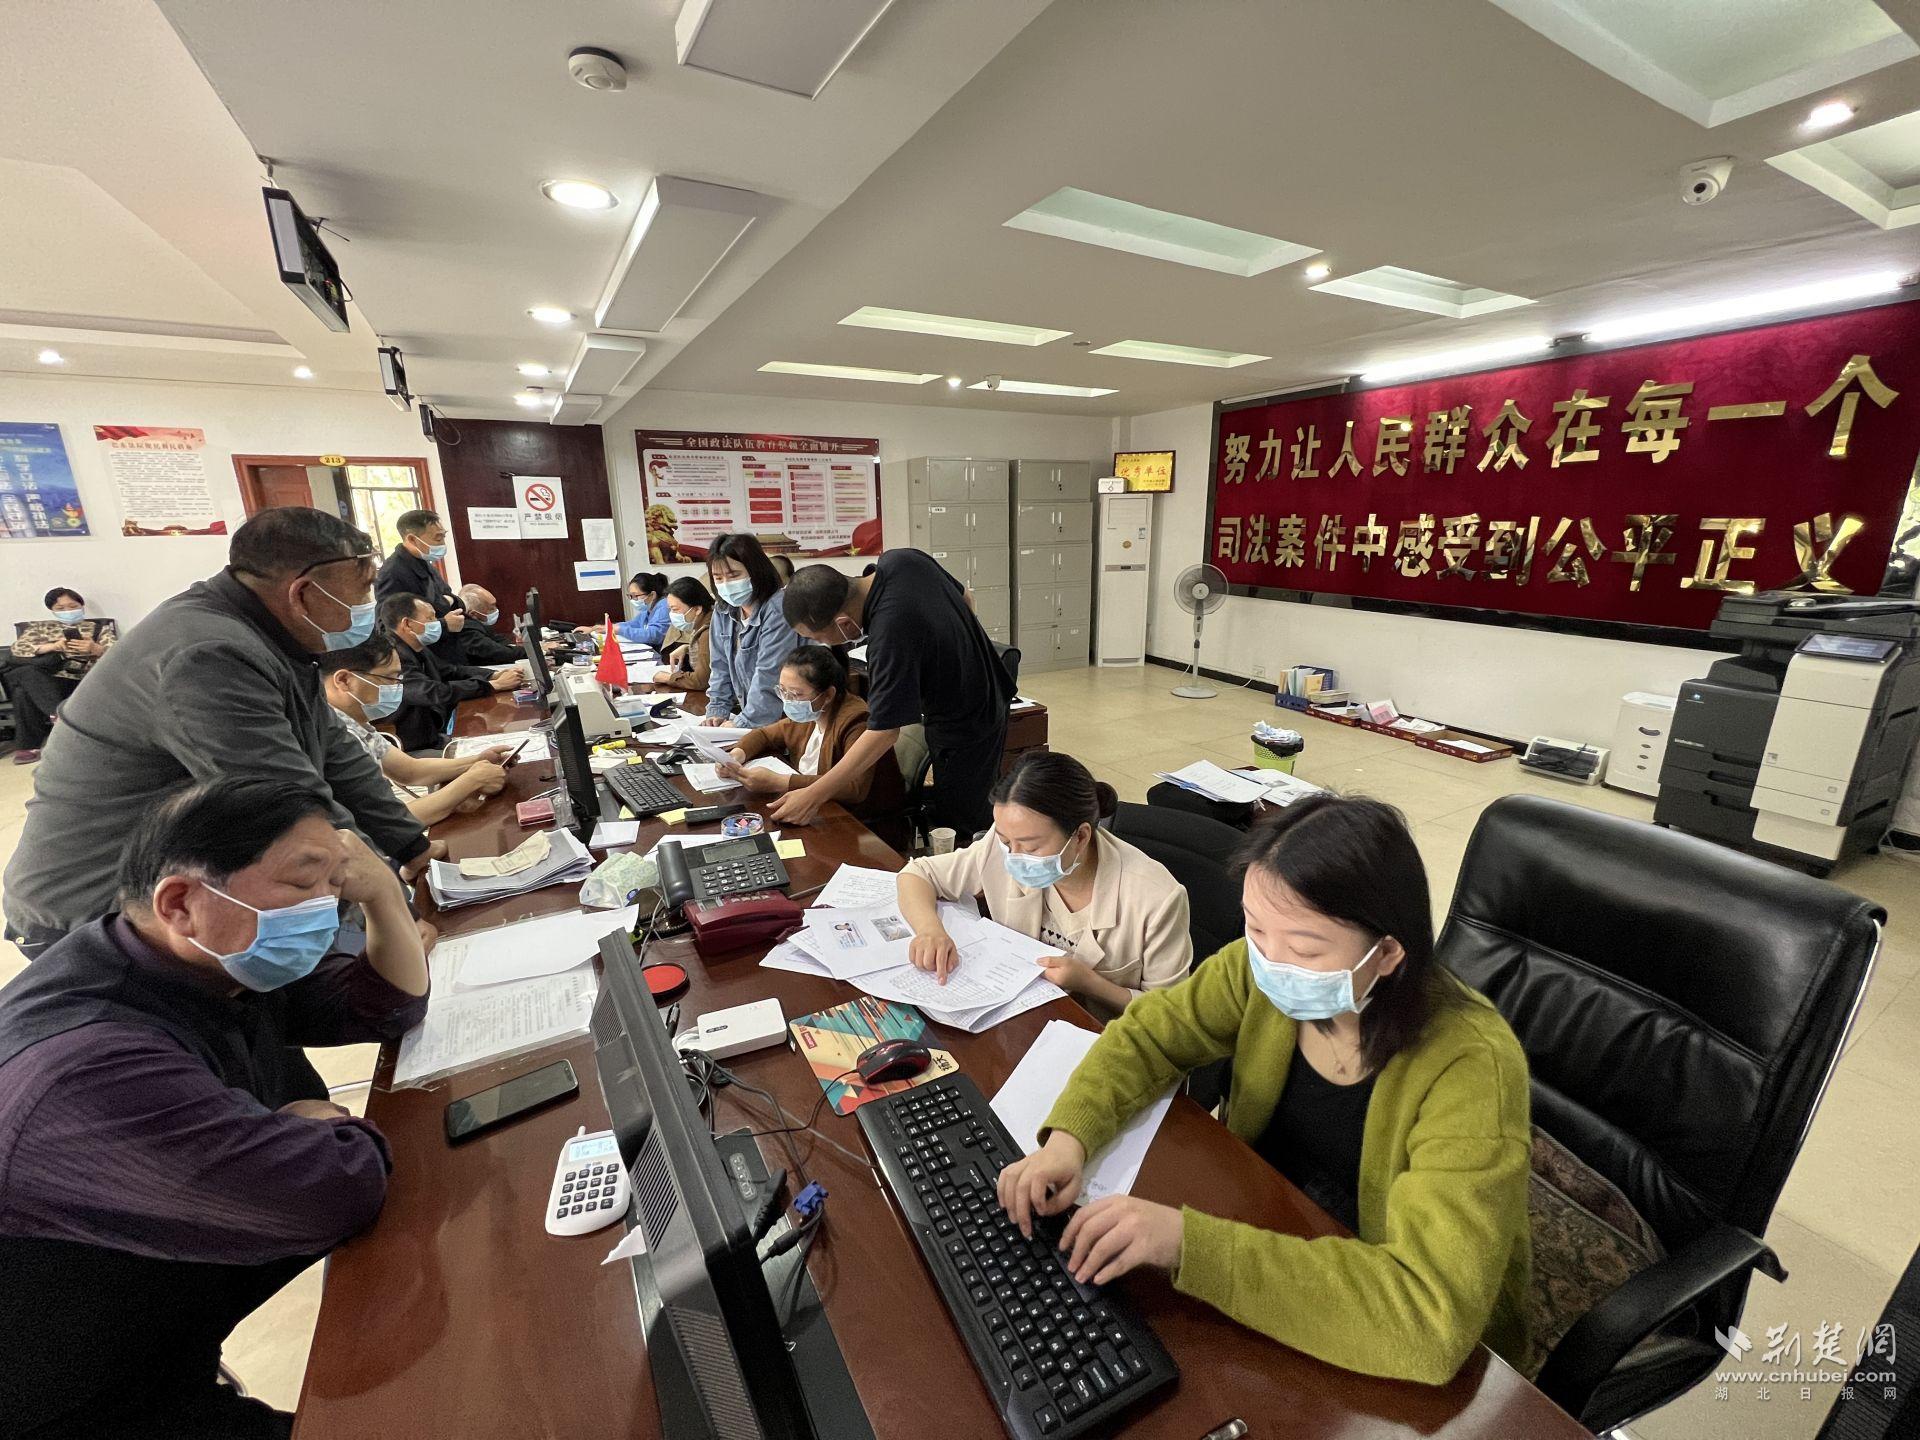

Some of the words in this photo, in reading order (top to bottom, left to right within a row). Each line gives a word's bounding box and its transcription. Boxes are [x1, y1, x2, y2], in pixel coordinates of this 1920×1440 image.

[1223, 354, 1900, 486] 努力让人民群众在每一个
[324, 456, 341, 464] 213
[524, 513, 563, 521] 严禁吸烟
[1217, 512, 1864, 596] 司法案件中感受到公平正义
